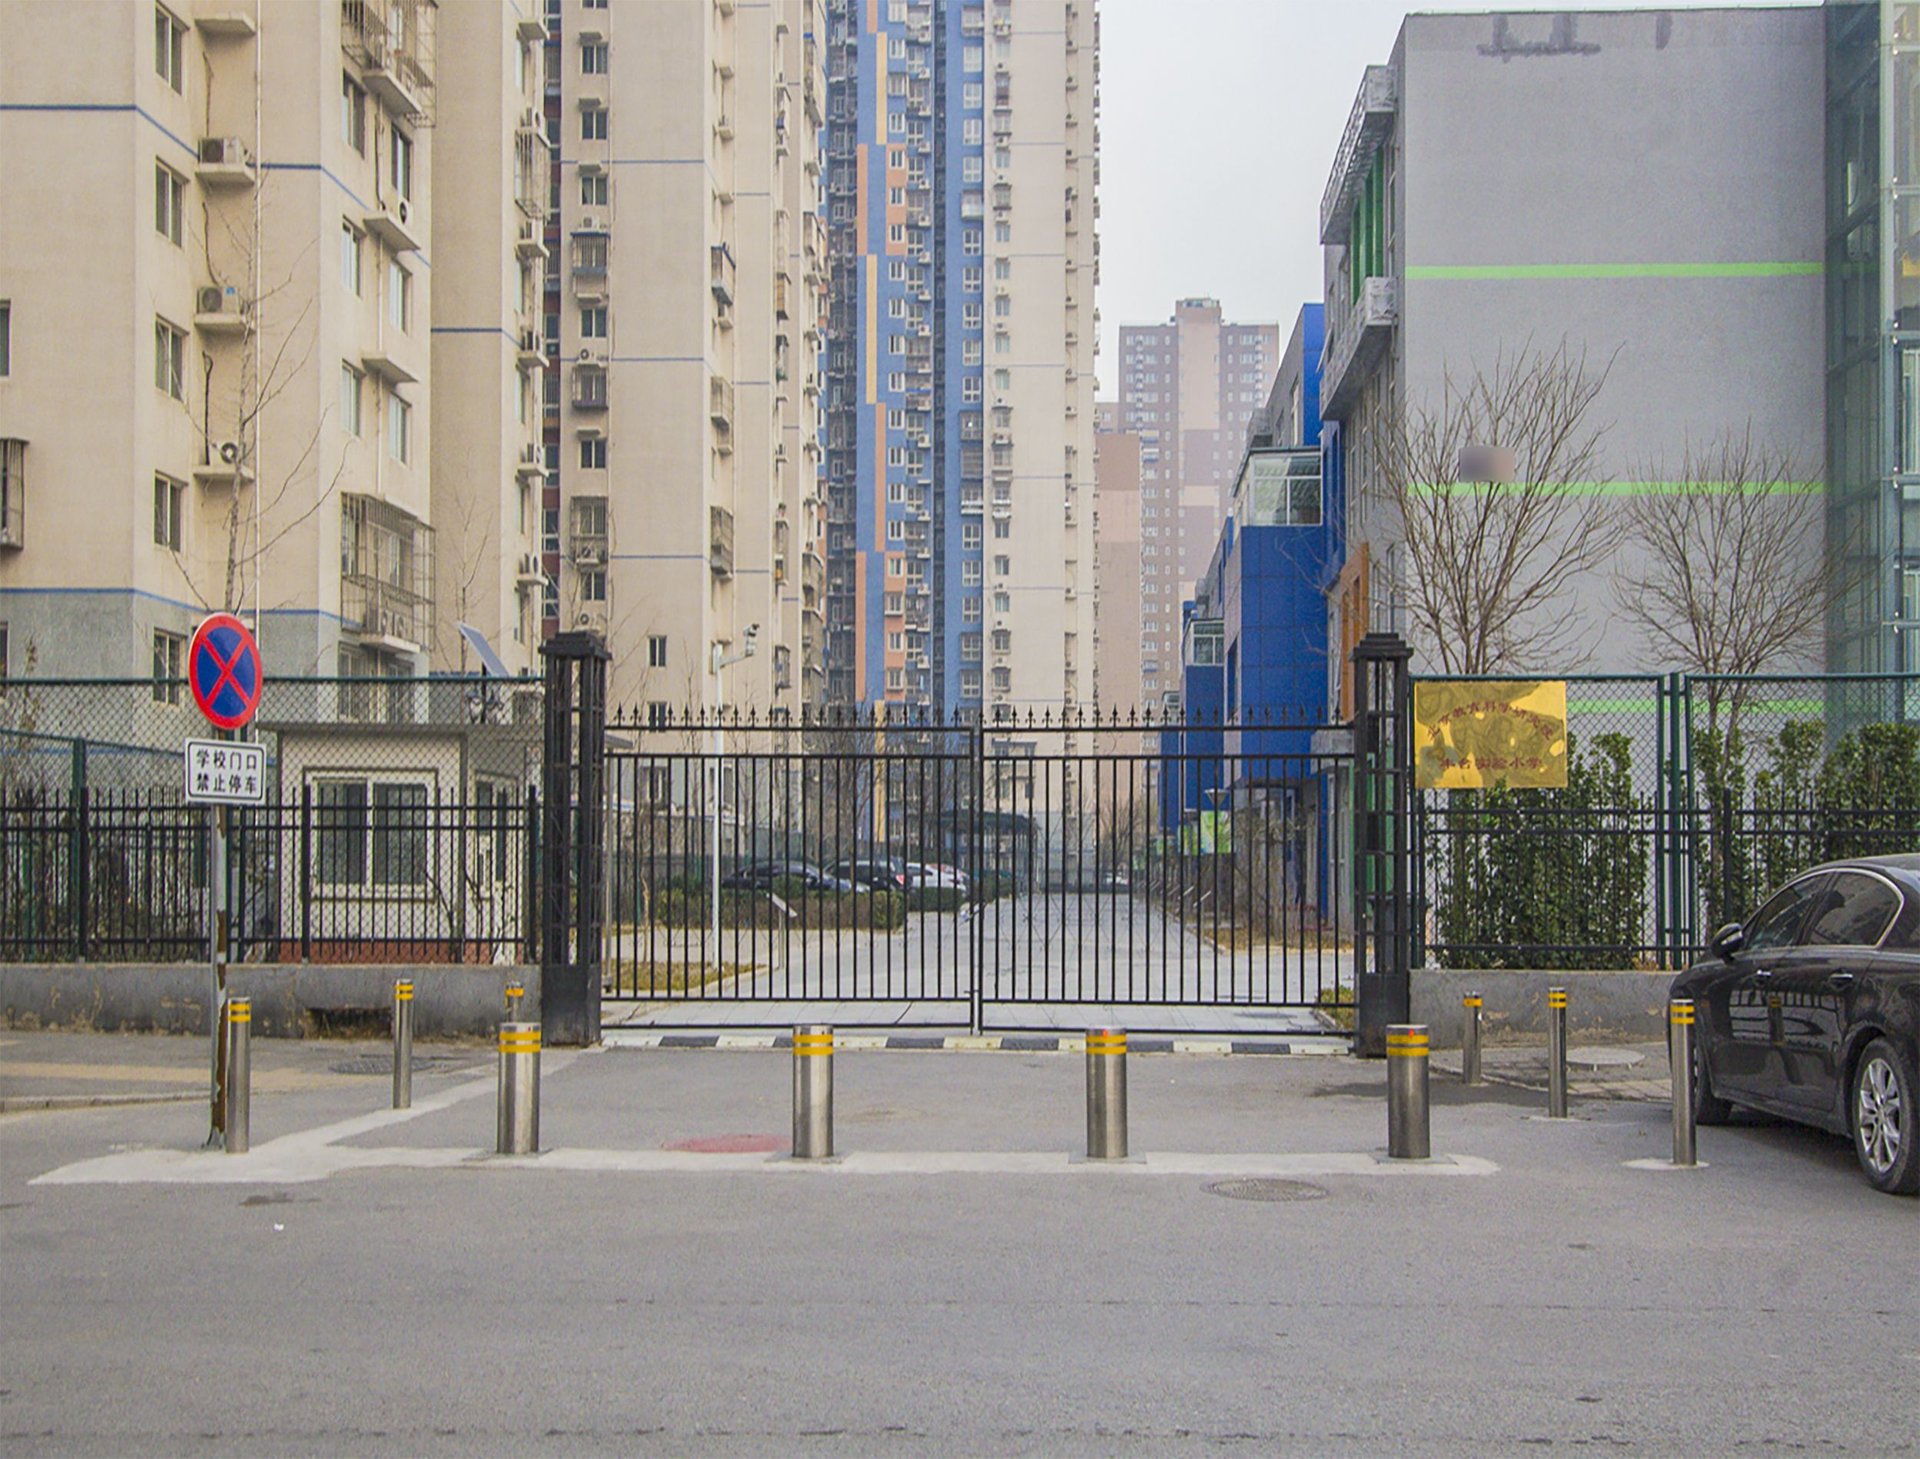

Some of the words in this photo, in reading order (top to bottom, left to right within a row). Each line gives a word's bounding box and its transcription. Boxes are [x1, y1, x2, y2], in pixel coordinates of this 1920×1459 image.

[196, 748, 257, 771] 学校门口
[196, 772, 257, 795] 禁止停车
